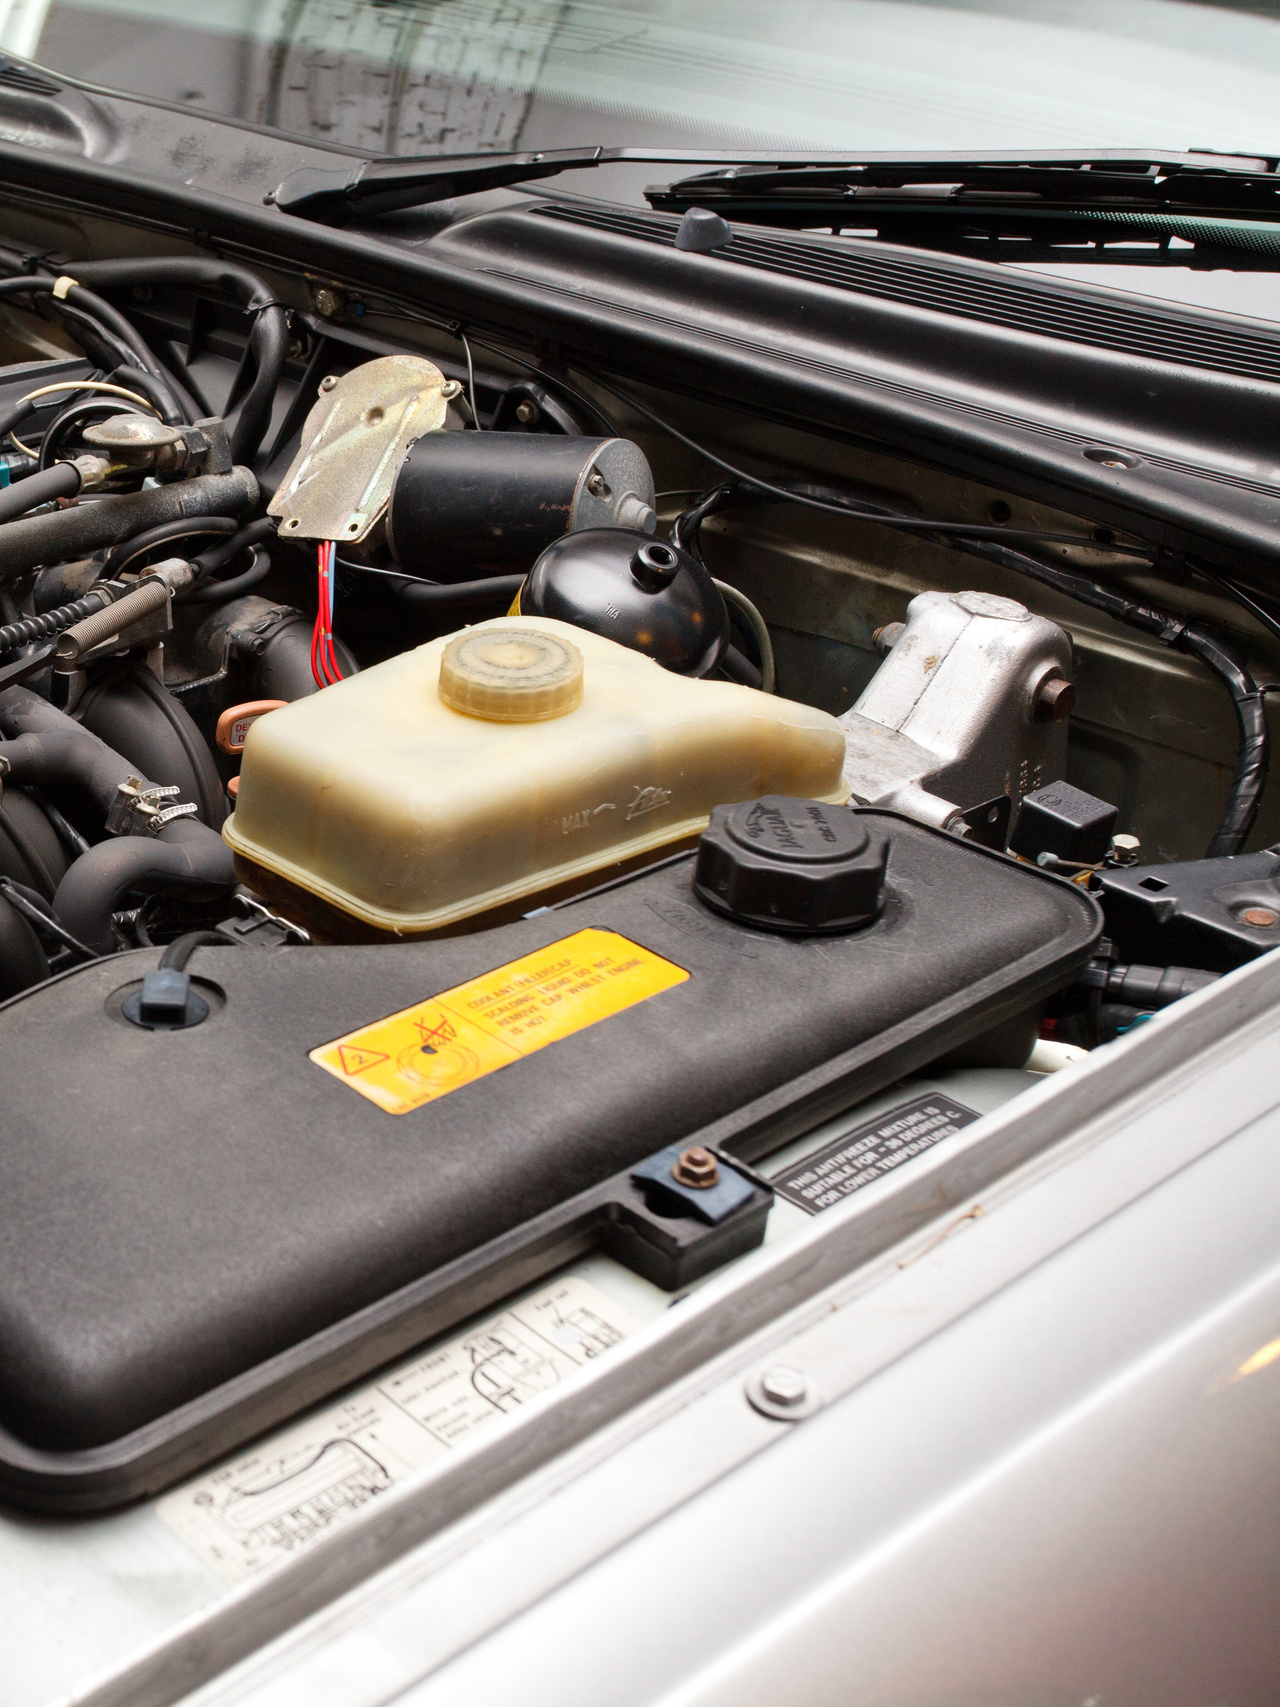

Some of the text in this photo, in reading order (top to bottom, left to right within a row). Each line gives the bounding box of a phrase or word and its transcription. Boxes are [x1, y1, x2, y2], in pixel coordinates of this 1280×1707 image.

[763, 808, 804, 849] JAGUAR
[573, 968, 591, 978] DO
[592, 957, 615, 969] NOT
[542, 994, 564, 1006] CAP
[787, 1106, 941, 1190] THIS ANTIFREEZE MIXTURE IS
[801, 1167, 857, 1199] SUITABLE
[852, 1151, 880, 1169] FOR
[901, 1115, 951, 1142] DEGREES
[814, 1125, 960, 1208] FOR LOWER TEMPERATURES
